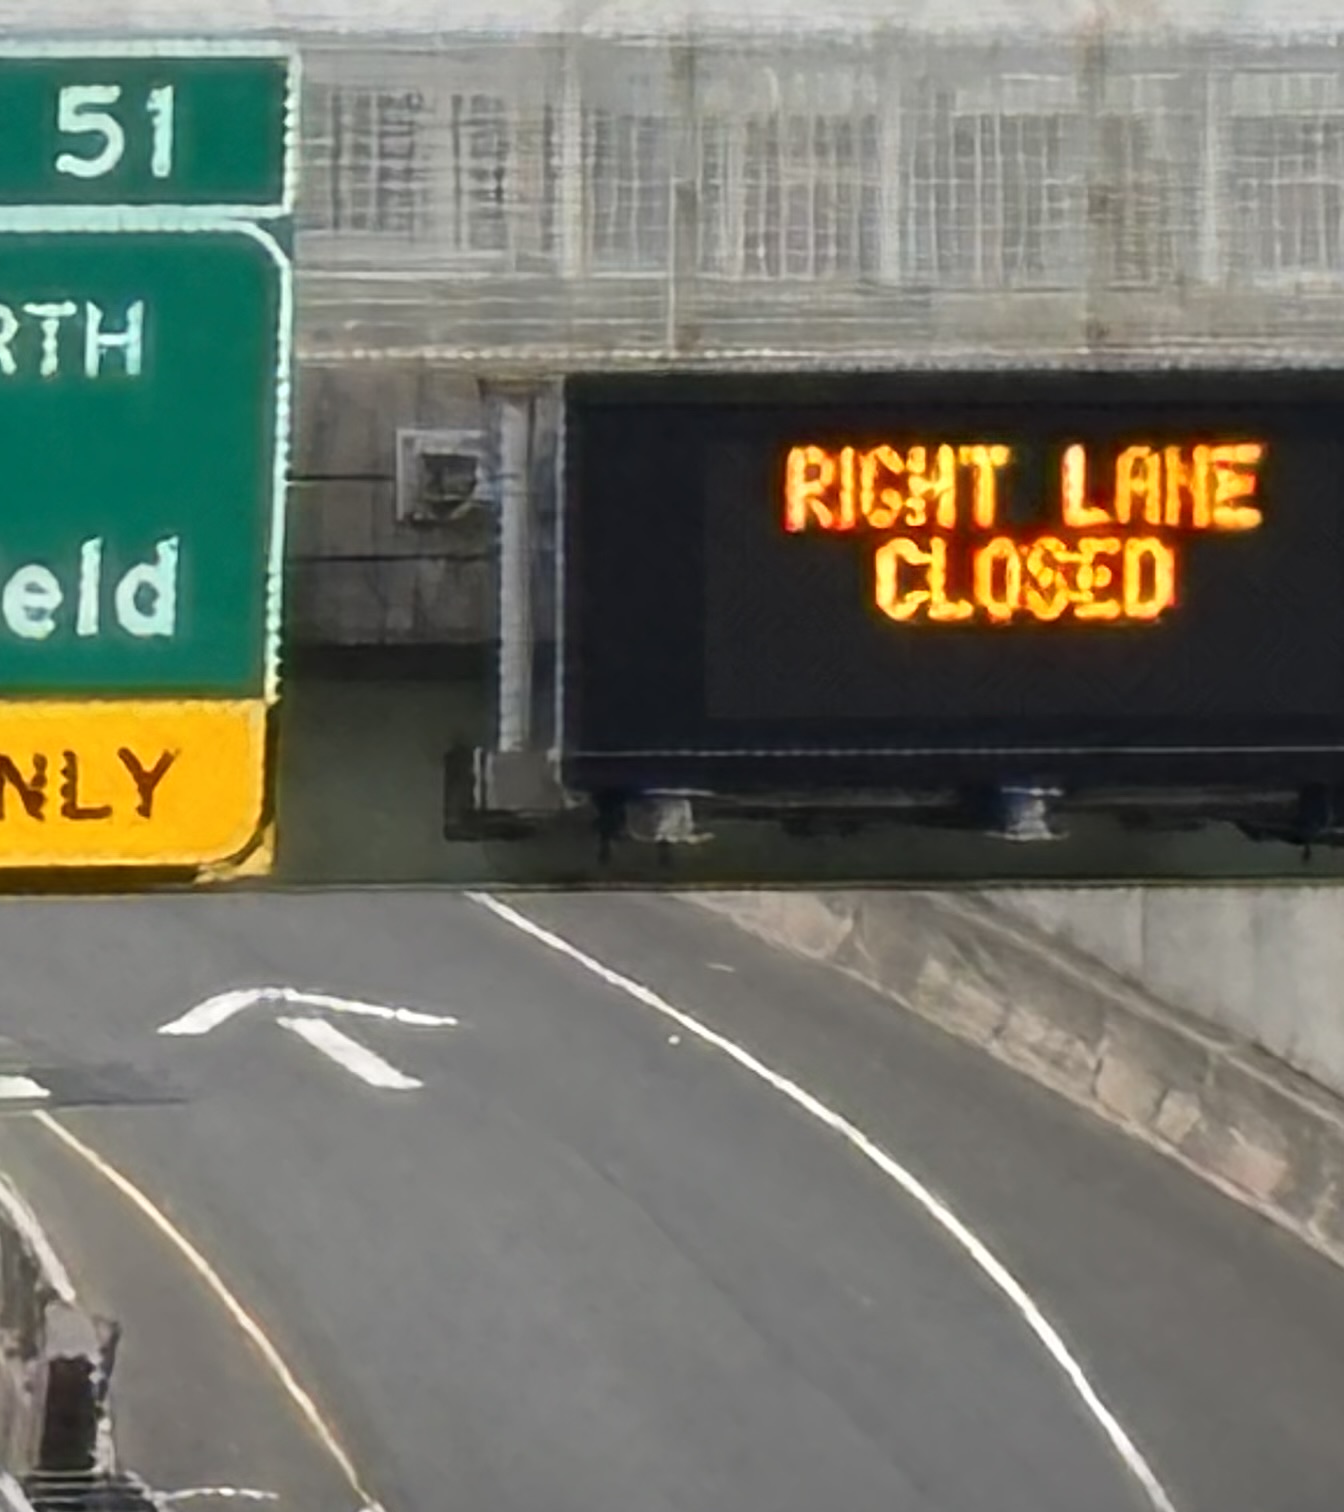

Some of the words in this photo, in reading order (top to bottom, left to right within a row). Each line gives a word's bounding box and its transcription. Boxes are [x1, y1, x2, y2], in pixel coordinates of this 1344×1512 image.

[55, 84, 175, 178] 51
[783, 443, 1011, 531] RIGHT
[1062, 443, 1266, 530] LANE
[874, 537, 1178, 624] CLOSED
